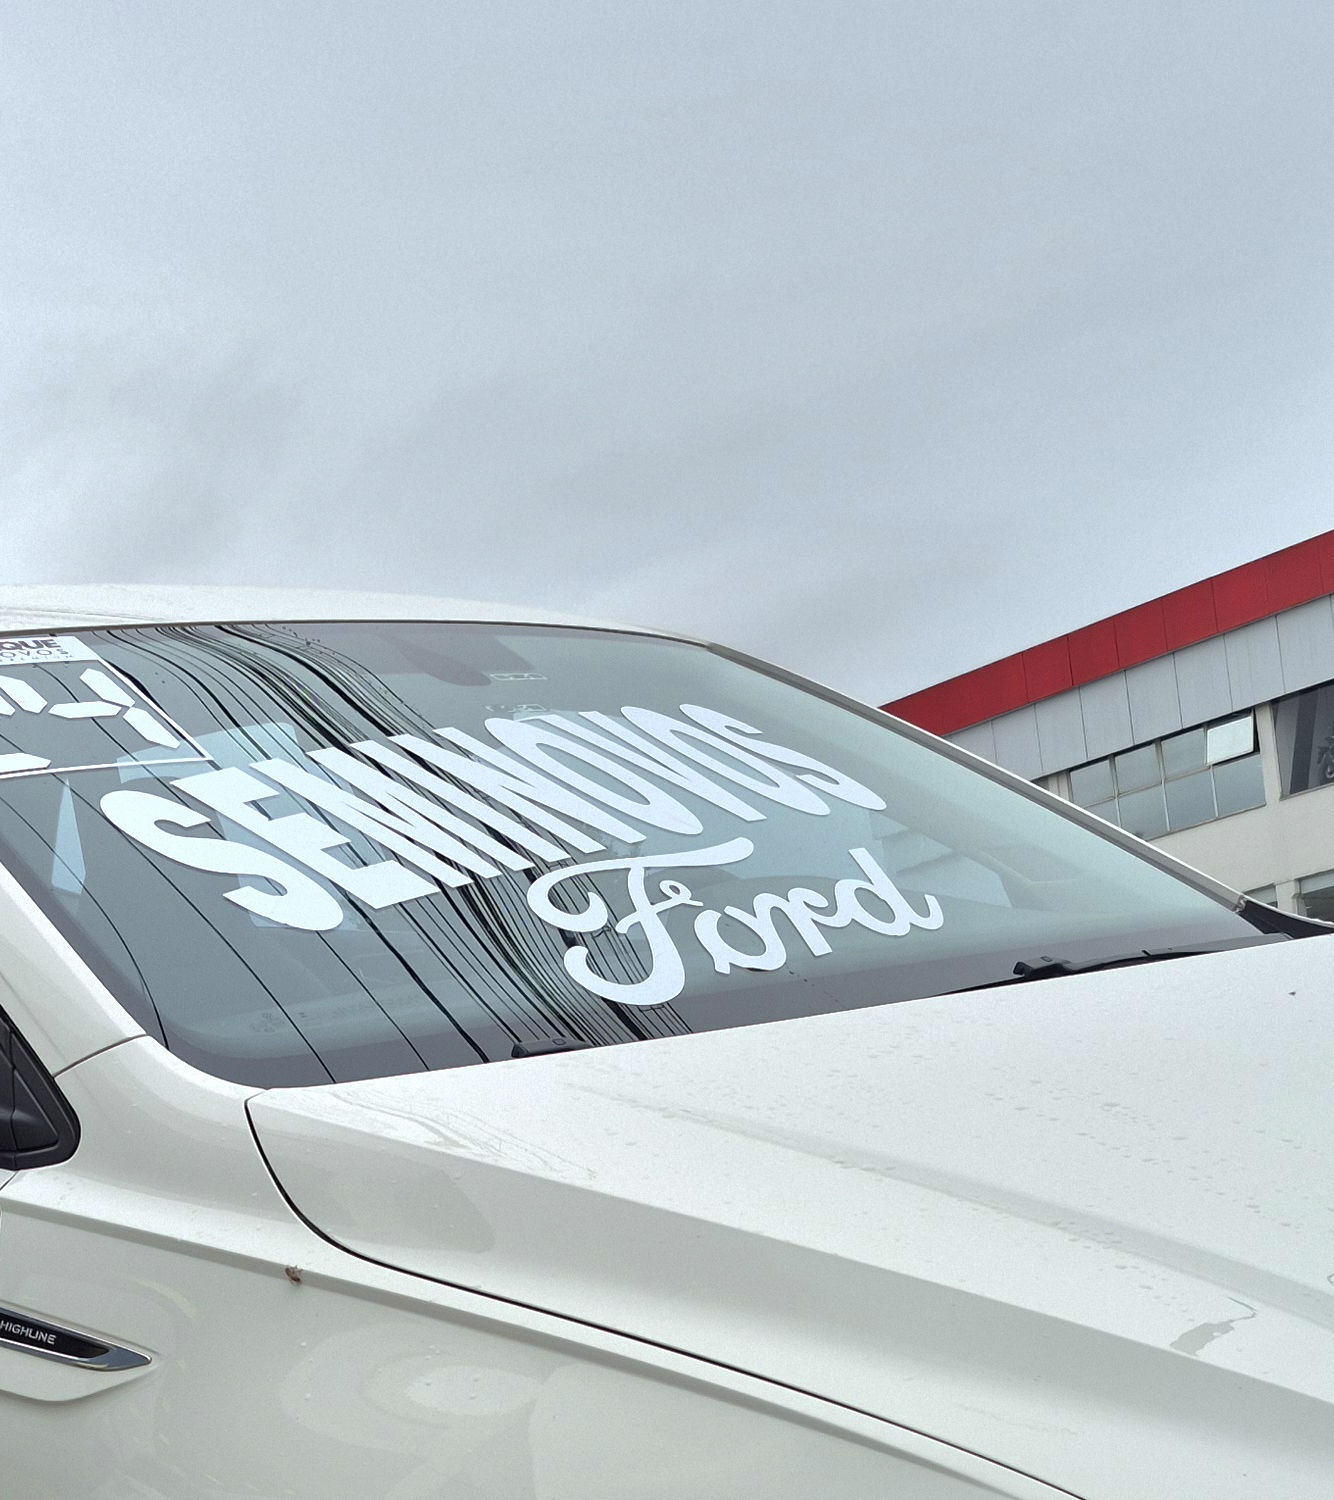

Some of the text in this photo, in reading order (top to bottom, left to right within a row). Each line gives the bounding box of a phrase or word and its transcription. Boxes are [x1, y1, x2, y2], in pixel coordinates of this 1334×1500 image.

[100, 703, 887, 933] SEMINOVOS
[525, 837, 943, 1006] Ford
[0, 1319, 57, 1345] HIGHLINE
